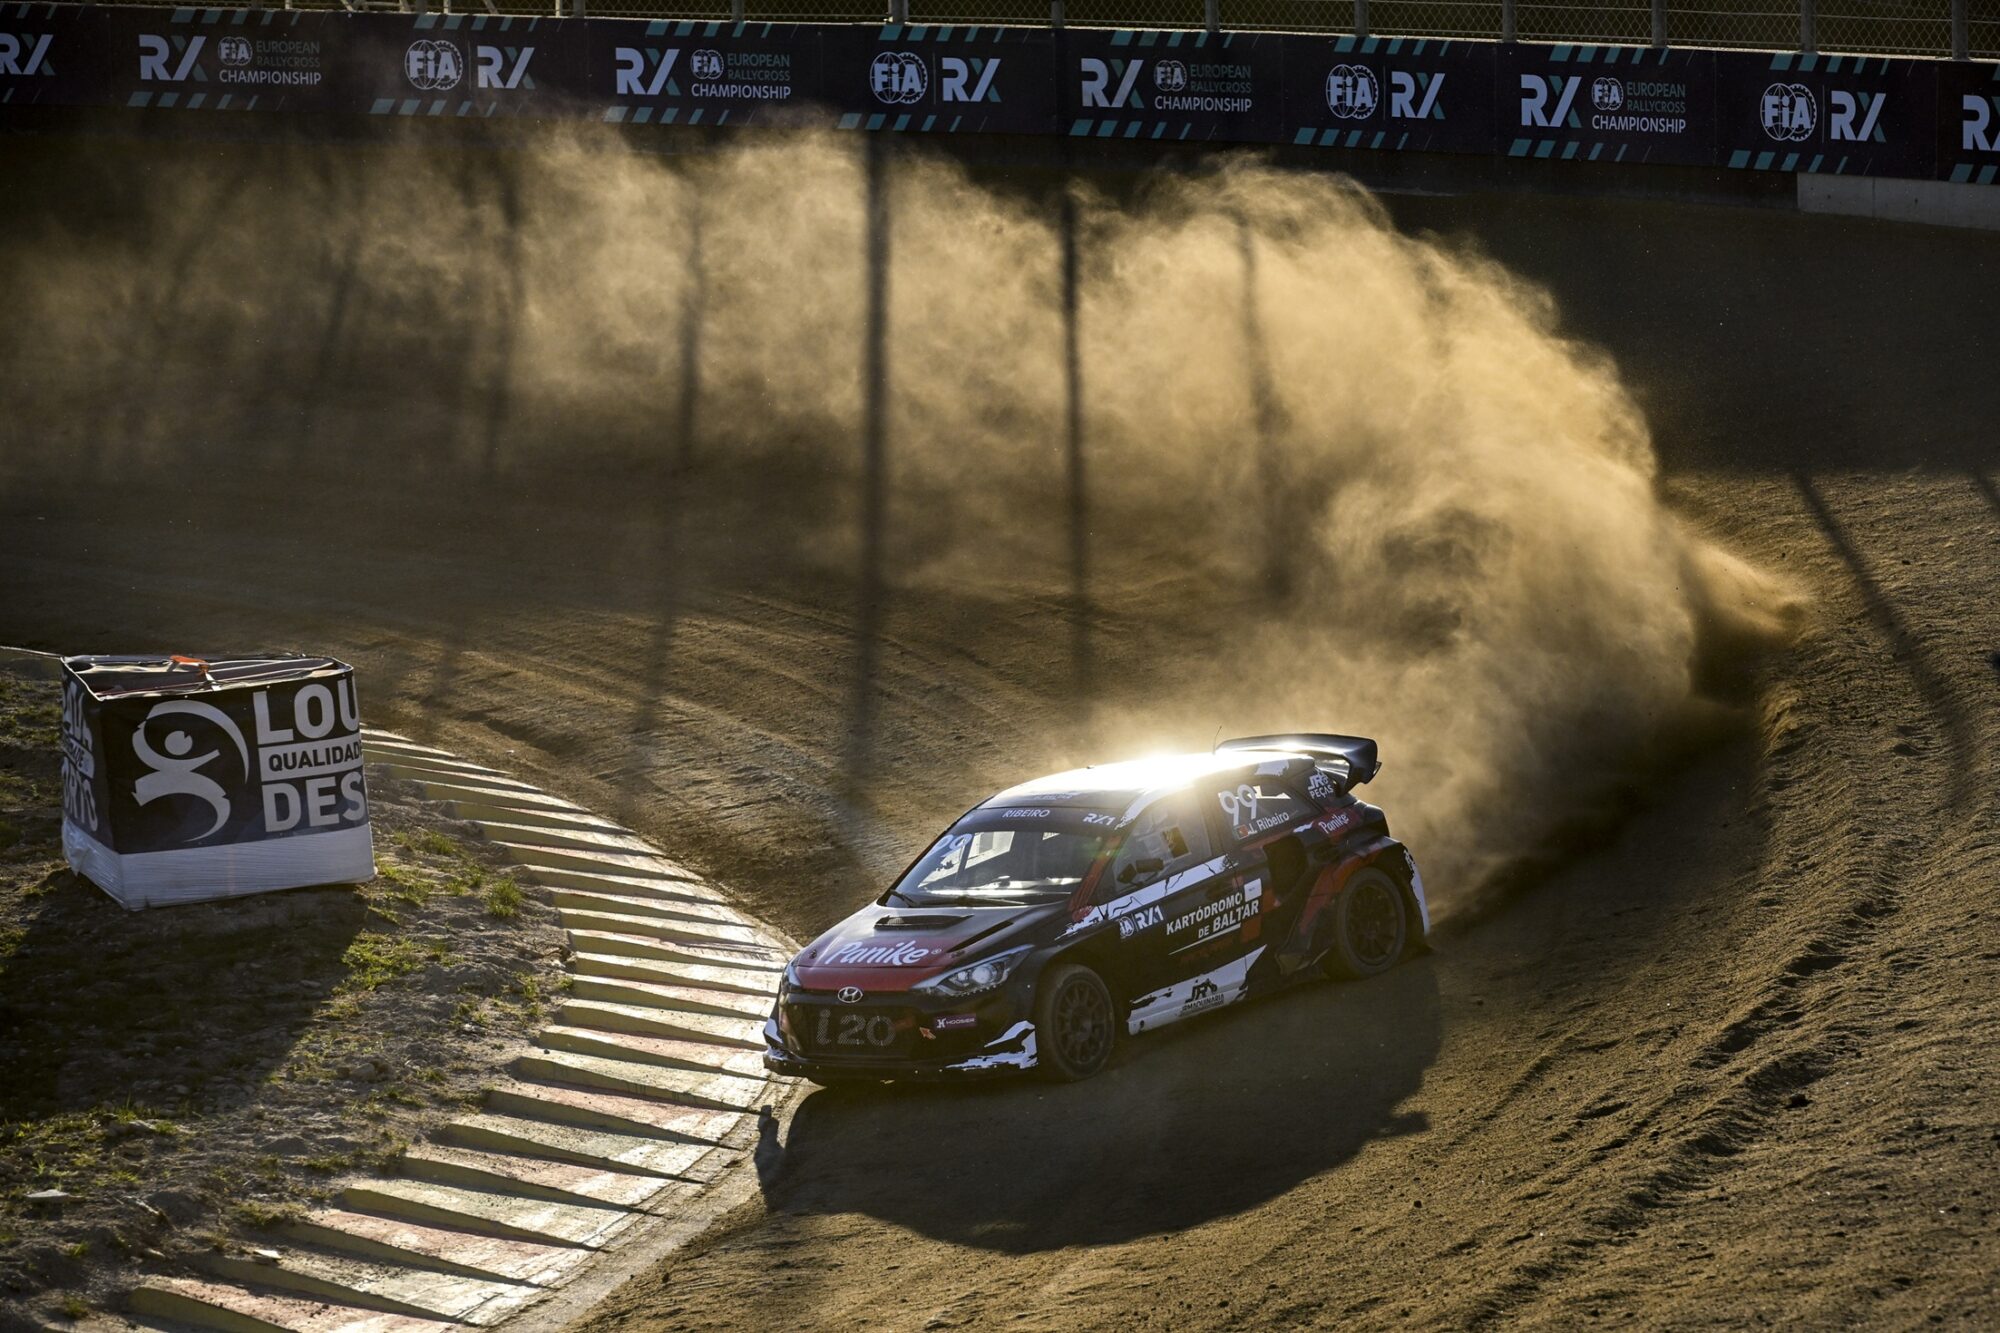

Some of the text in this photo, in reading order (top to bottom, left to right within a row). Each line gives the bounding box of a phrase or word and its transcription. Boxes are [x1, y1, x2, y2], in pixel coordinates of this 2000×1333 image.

[139, 34, 208, 82] RX
[256, 40, 320, 54] EUROPEAN
[727, 52, 791, 68] EUROPEAN
[256, 55, 321, 68] RALLYCROSS
[477, 46, 535, 90] RX
[615, 47, 681, 96] RX
[1190, 63, 1251, 79] EUROPEAN
[219, 69, 322, 85] CHAMPIONSHIP
[727, 69, 791, 82] RALLYCROSS
[942, 57, 1002, 103] RX
[1081, 57, 1144, 109] RX
[1190, 80, 1251, 94] RALLYCROSS
[691, 83, 792, 99] CHAMPIONSHIP
[1391, 71, 1446, 120] RX
[1520, 74, 1582, 129] RX
[1626, 81, 1686, 98] EUROPEAN
[1154, 95, 1252, 113] CHAMPIONSHIP
[1626, 99, 1686, 114] RALLYCROSS
[1831, 90, 1887, 143] RX
[1592, 114, 1687, 134] CHAMPIONSHIP
[1962, 94, 2000, 152] R
[253, 676, 360, 745] LOU
[268, 739, 361, 772] QUALIDAD
[262, 771, 365, 833] DES
[1002, 808, 1050, 819] RIBEIRO
[1220, 784, 1257, 828] 99
[1082, 813, 1116, 826] RX1
[1247, 811, 1290, 836] J. Ribeiro
[1318, 812, 1350, 836] Panike
[1134, 904, 1164, 930] RX1
[1166, 892, 1243, 936] KARTÓDROMO
[1198, 899, 1260, 939] DE BALTAR
[824, 940, 929, 966] Panike
[815, 1008, 897, 1047] i20
